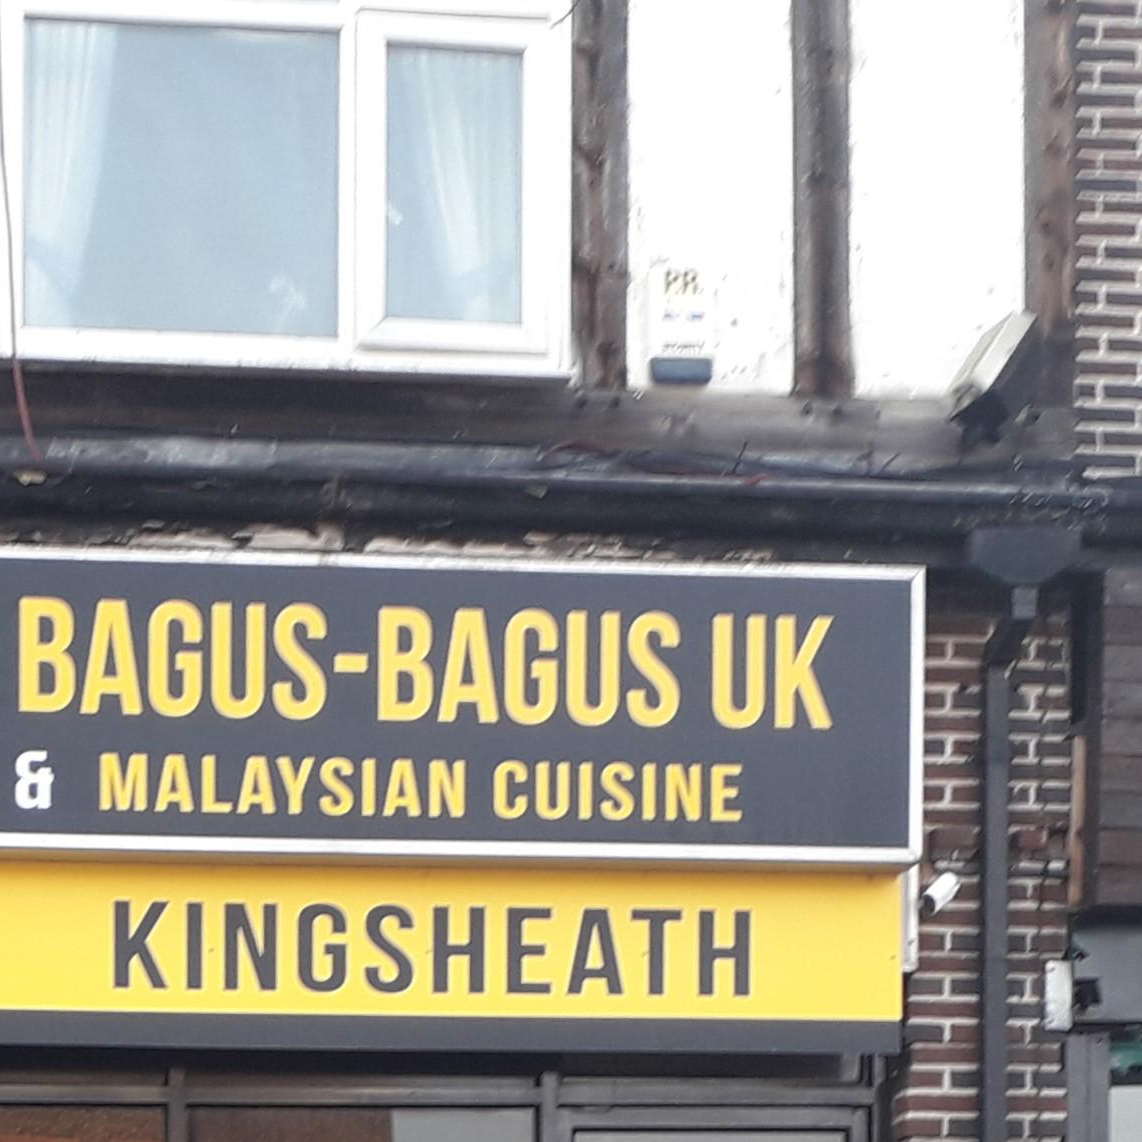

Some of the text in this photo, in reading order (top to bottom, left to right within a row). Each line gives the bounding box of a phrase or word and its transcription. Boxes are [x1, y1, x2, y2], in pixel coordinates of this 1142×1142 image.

[18, 595, 834, 731] BAGUS-BAGUS UK
[14, 750, 54, 811] &
[98, 752, 467, 819] MALAYSIAN
[492, 760, 743, 823] CUISINE
[112, 899, 752, 998] KINGSHEATH
